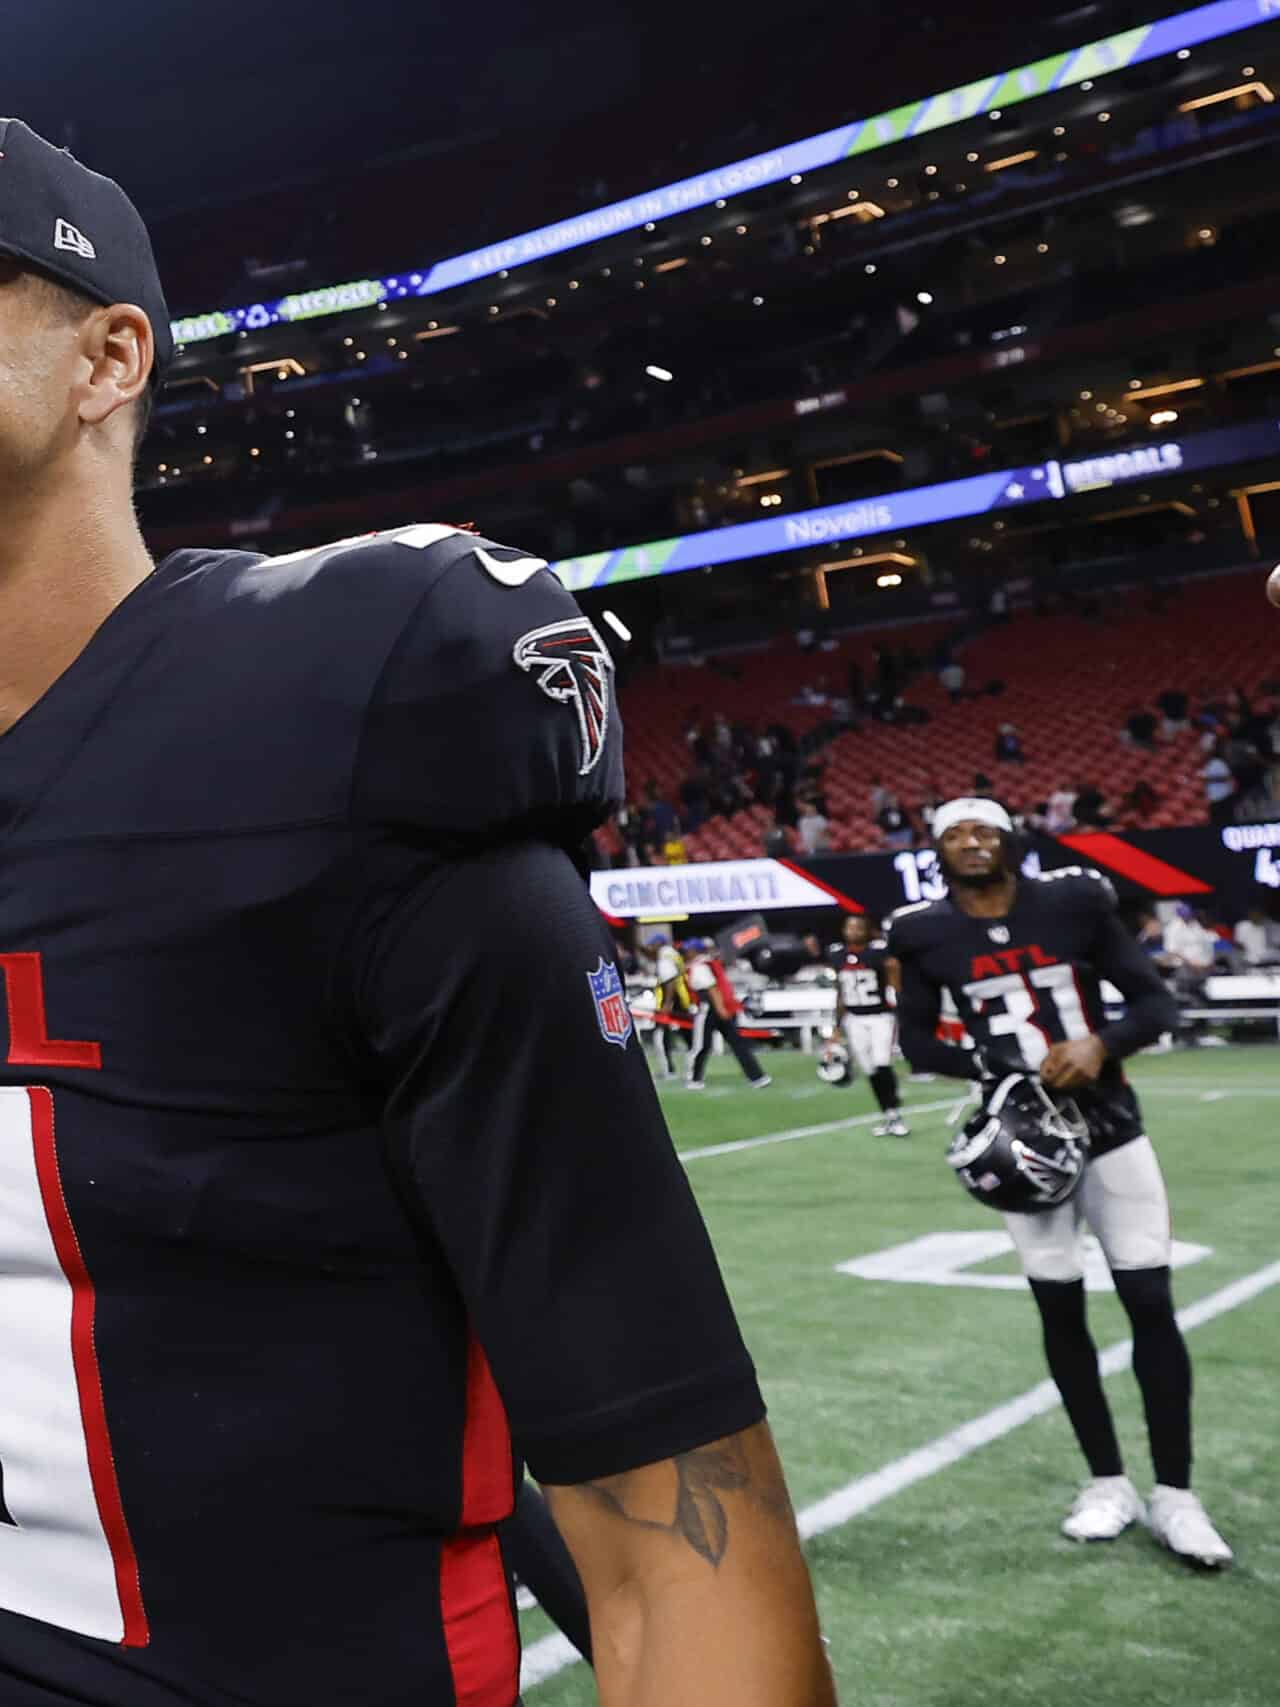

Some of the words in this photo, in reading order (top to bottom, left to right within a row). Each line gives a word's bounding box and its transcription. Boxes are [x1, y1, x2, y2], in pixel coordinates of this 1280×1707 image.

[784, 503, 892, 544] Novelis
[607, 871, 779, 909] CINCINNATI
[972, 944, 1057, 981] ATL
[600, 995, 629, 1033] NFL
